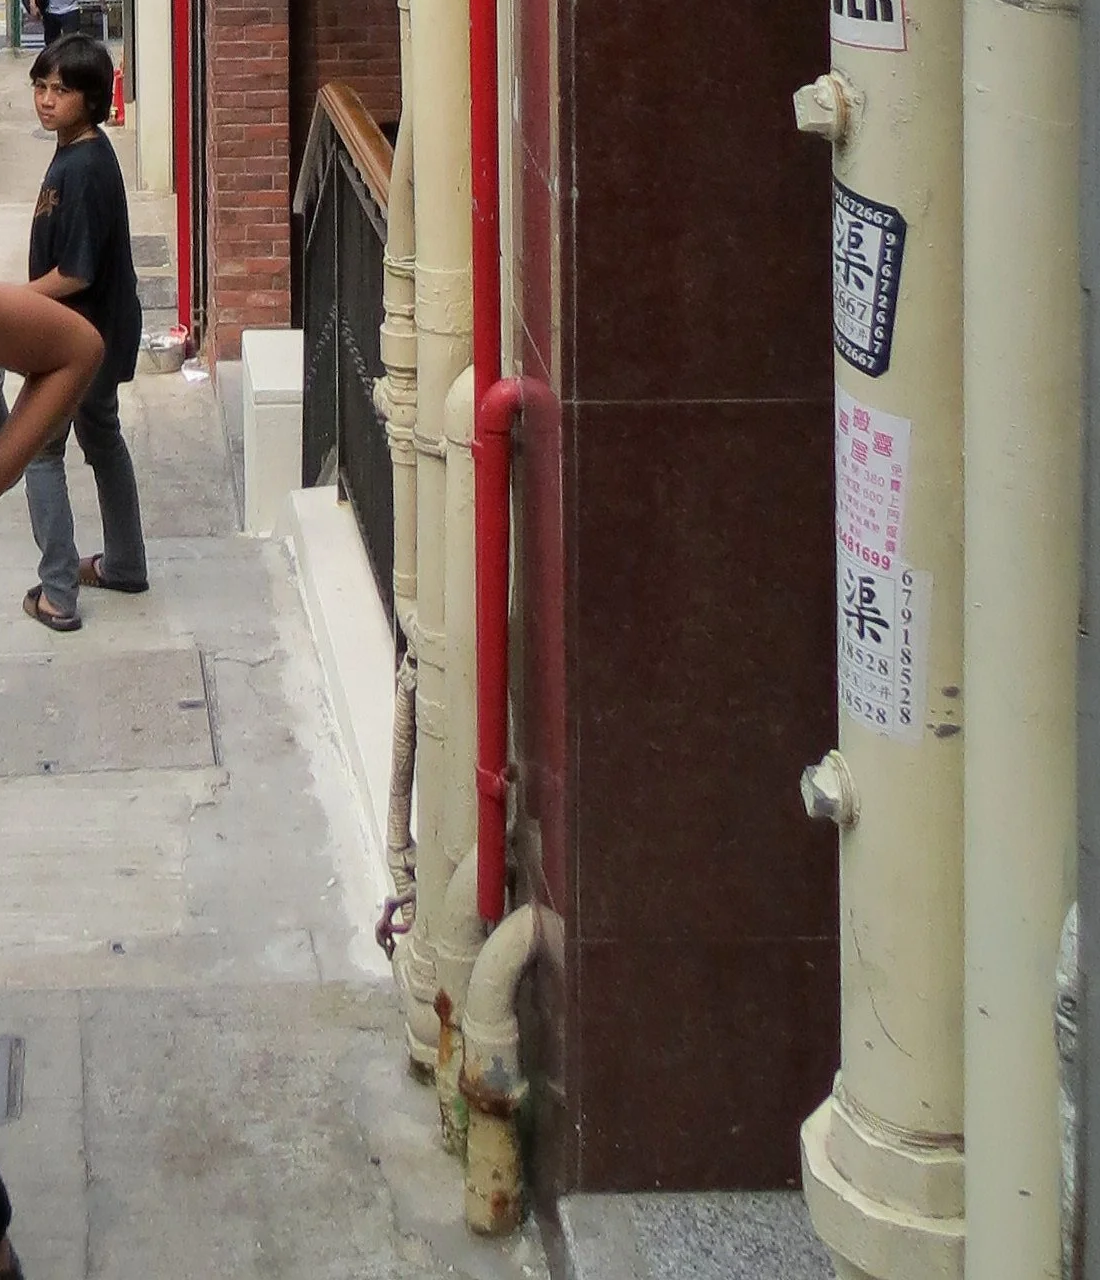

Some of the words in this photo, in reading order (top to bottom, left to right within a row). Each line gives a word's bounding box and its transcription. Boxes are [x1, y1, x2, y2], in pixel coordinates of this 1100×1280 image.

[835, 211, 874, 291] 渠
[874, 231, 897, 355] 91672667
[842, 567, 890, 644] 渠
[899, 569, 914, 725] 67918528
